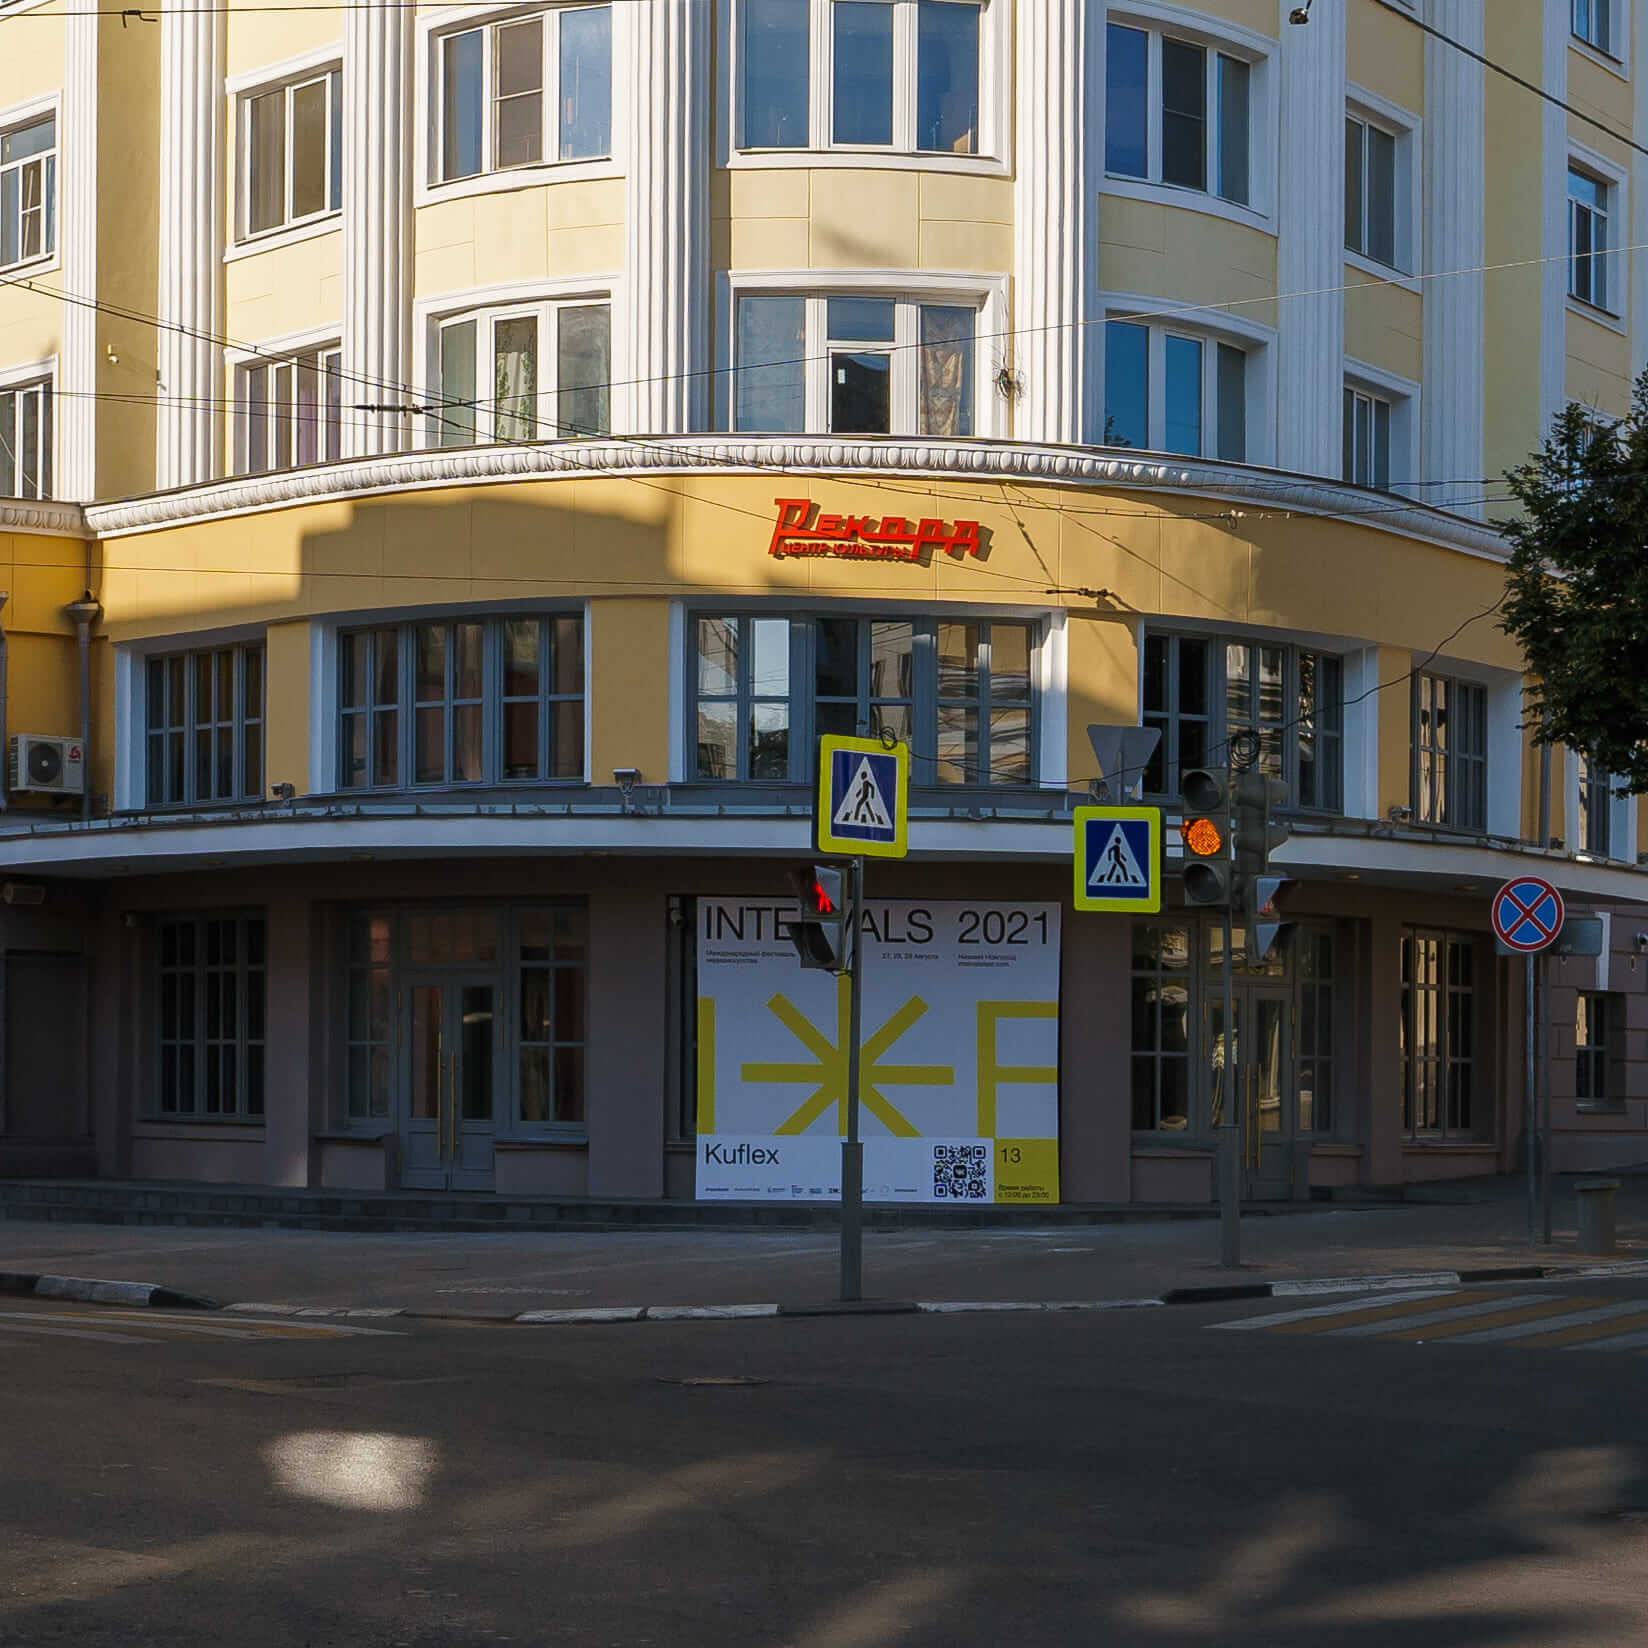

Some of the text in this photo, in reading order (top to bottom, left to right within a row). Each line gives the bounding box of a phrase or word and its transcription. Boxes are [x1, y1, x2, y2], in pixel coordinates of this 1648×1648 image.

[782, 542, 828, 554] ЦЕНТР
[705, 906, 1048, 944] INTEALS 2021
[705, 1143, 780, 1165] Kuflex
[1000, 1148, 1021, 1164] 13
